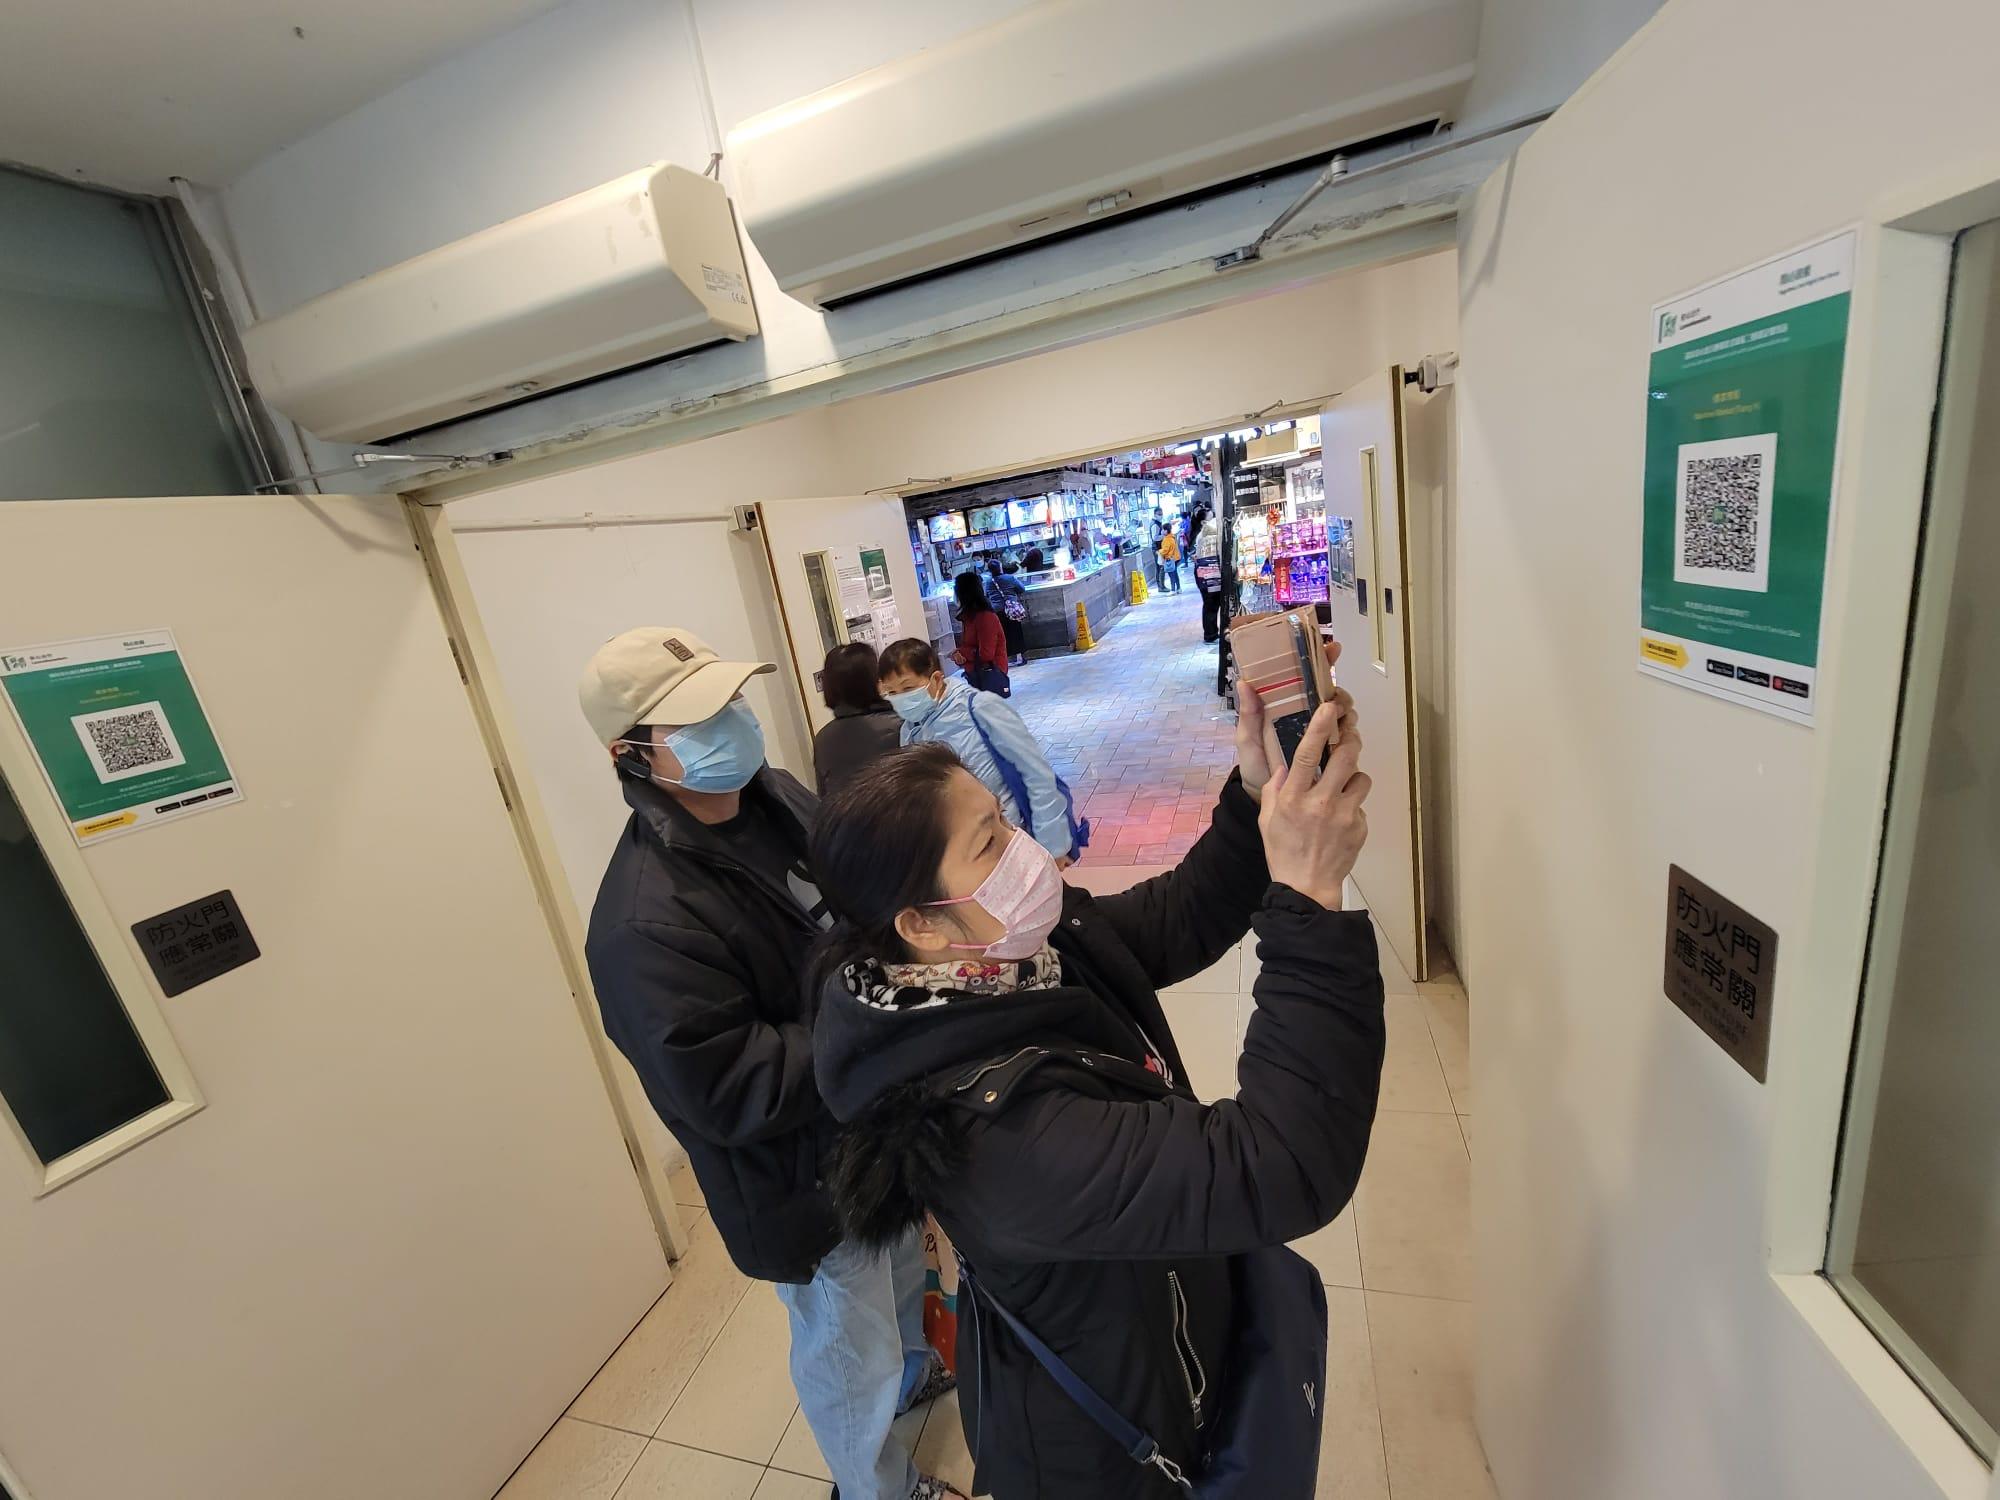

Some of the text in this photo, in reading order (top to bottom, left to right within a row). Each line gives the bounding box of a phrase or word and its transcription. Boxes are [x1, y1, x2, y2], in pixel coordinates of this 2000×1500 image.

[146, 900, 230, 946] 防火門
[159, 921, 239, 968] 應常關
[1677, 885, 1760, 975] 防火門
[1673, 928, 1757, 1020] 應常關
